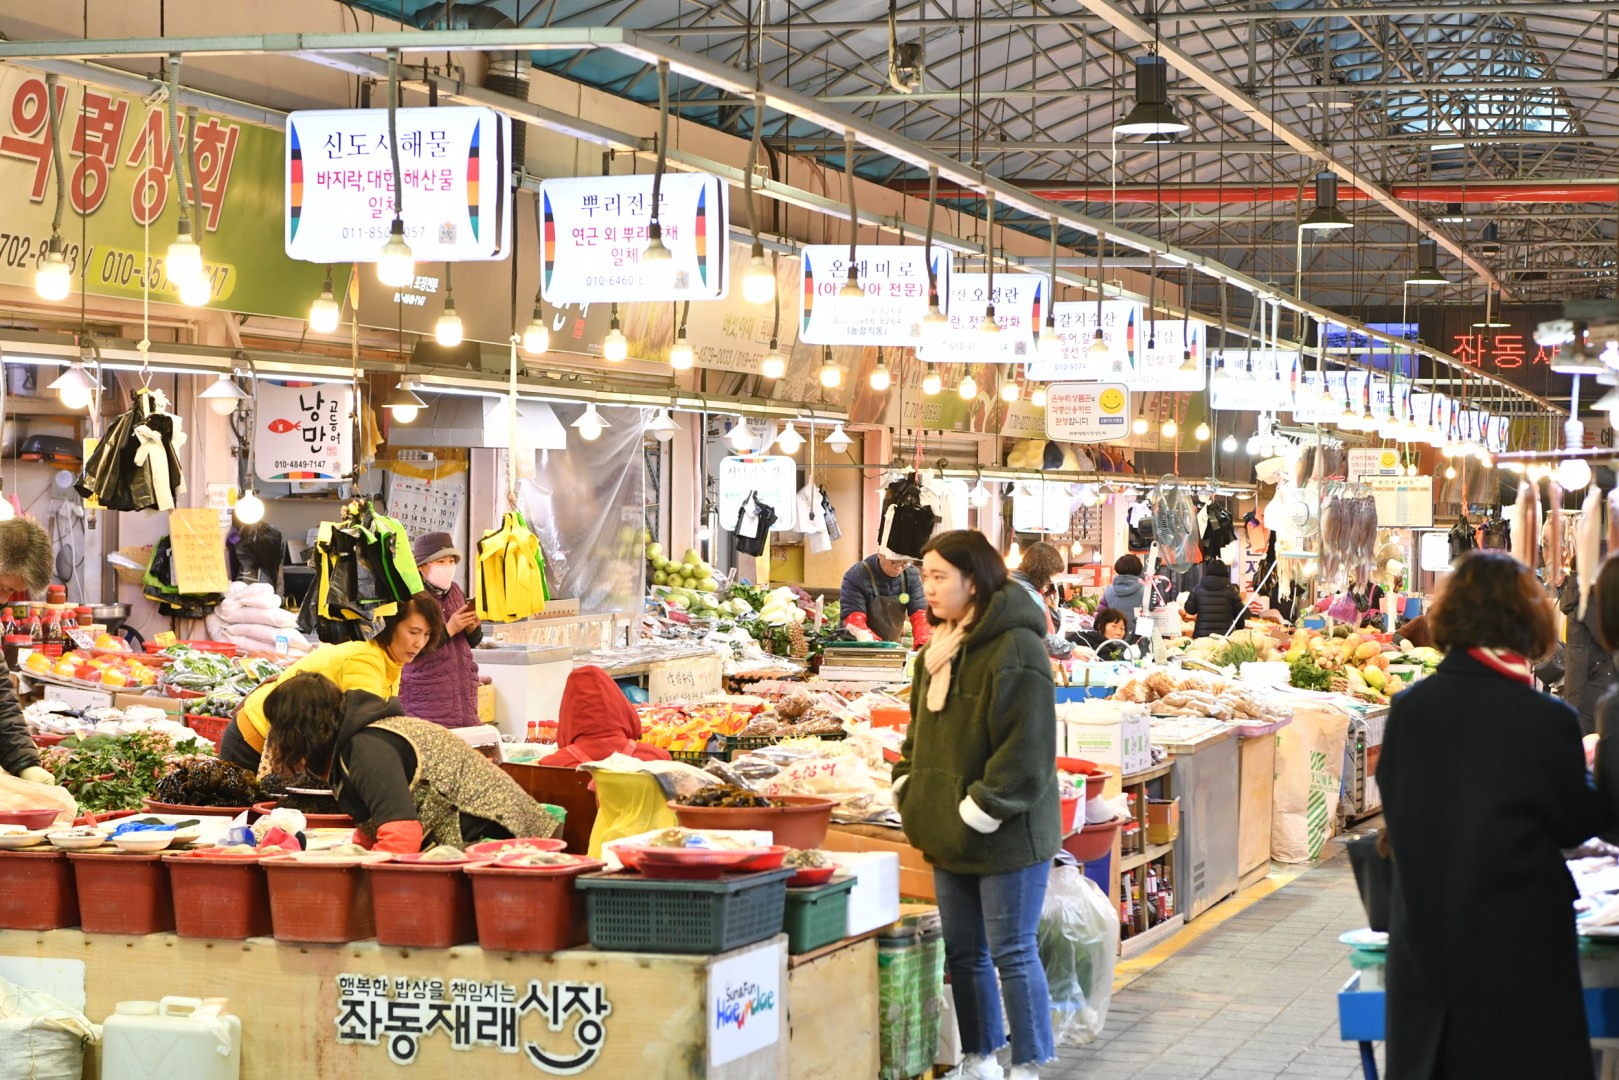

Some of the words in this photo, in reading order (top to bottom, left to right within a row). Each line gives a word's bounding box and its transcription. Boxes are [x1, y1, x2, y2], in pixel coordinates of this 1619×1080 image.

[0, 78, 239, 231] 의령상회
[404, 169, 454, 191] 해산물
[572, 227, 598, 246] 연근
[604, 227, 617, 242] 외
[611, 247, 638, 266] 일체
[889, 283, 923, 297] 전문)
[299, 390, 327, 453] 낭만
[329, 400, 341, 445] 고등어
[274, 460, 326, 469] 010-4849-7147
[339, 977, 388, 998] 행복한
[395, 979, 444, 1000] 밥상을
[451, 982, 515, 1003] 책임지는
